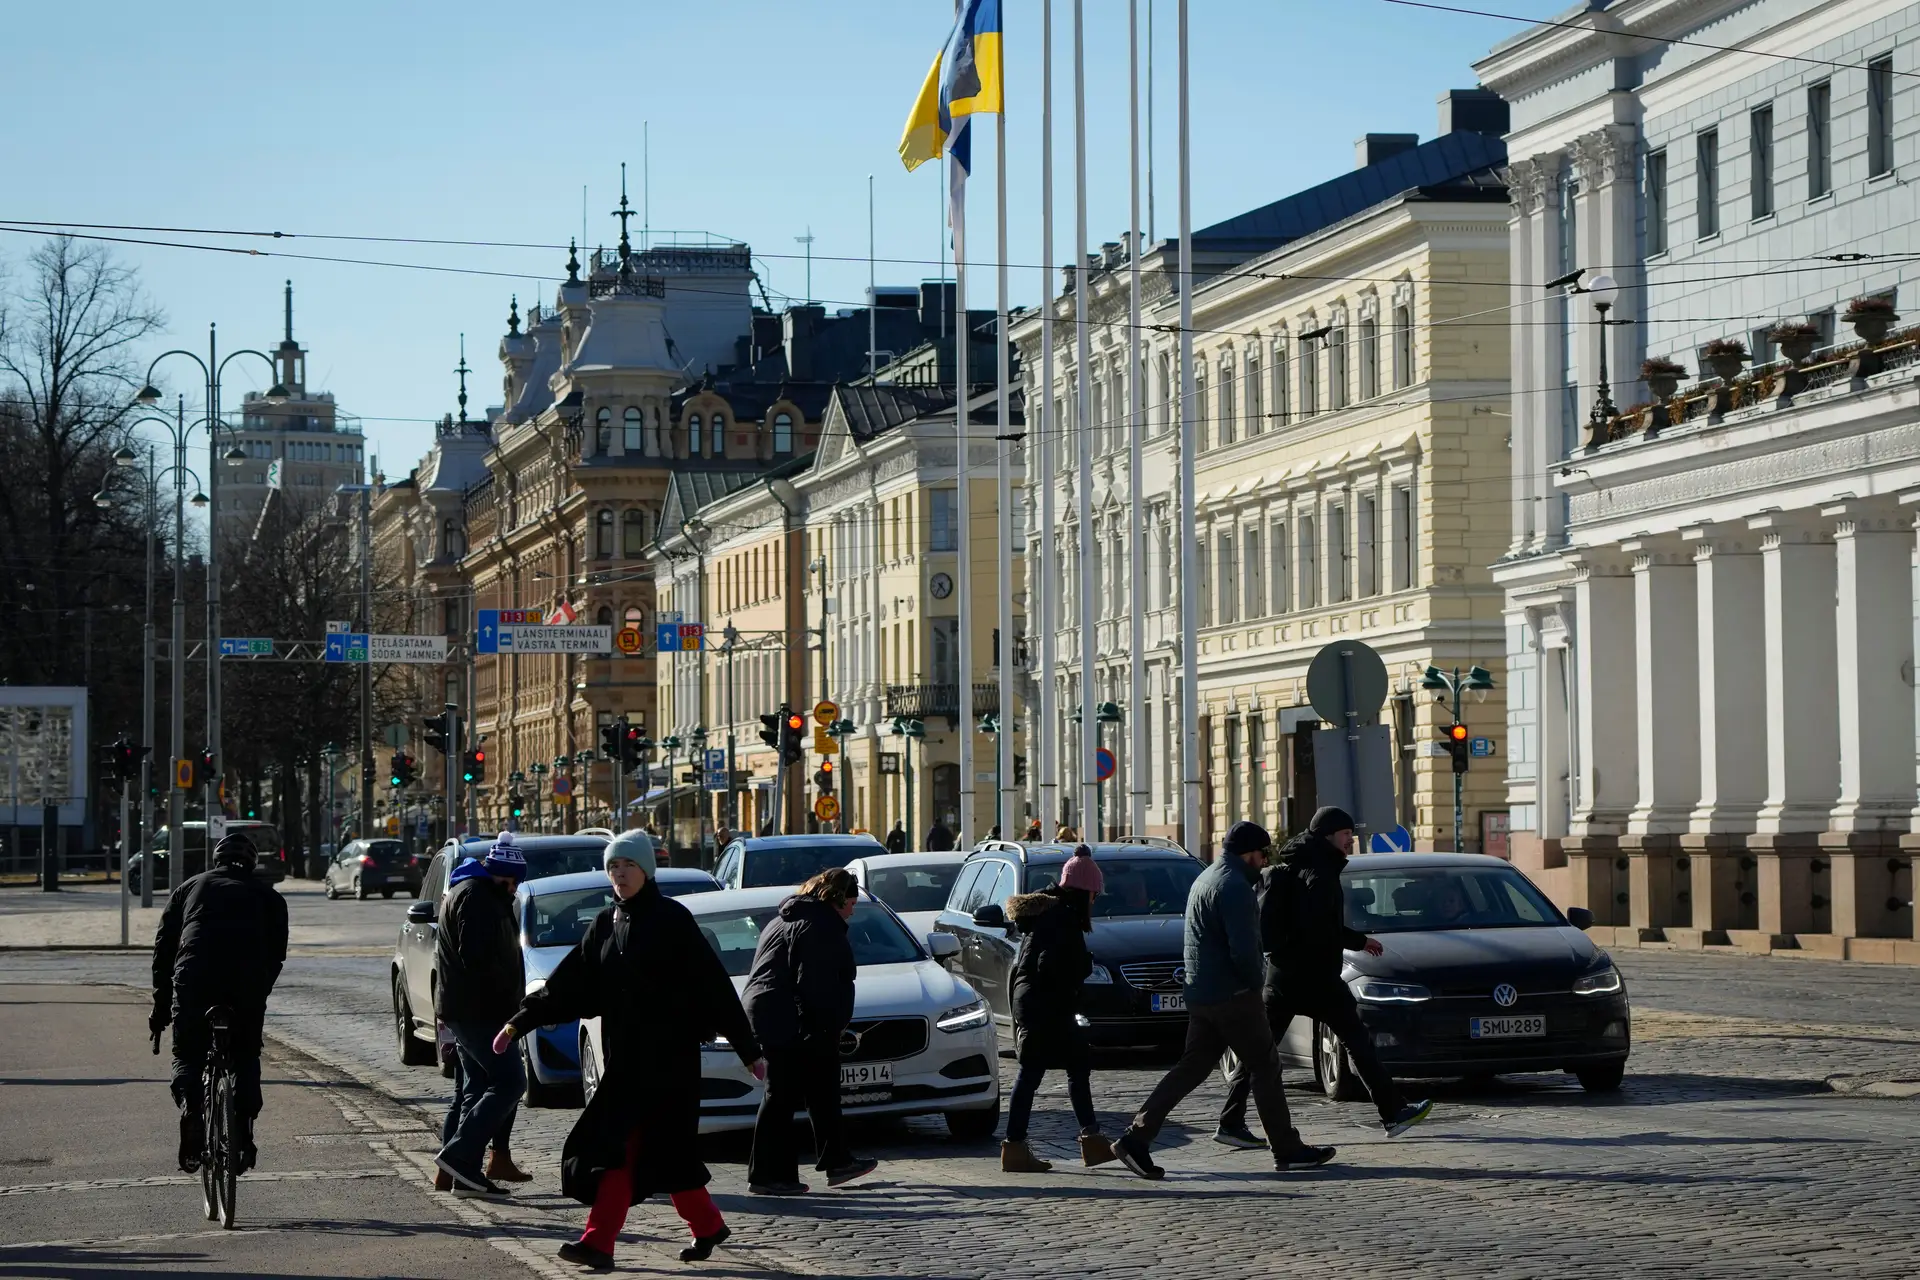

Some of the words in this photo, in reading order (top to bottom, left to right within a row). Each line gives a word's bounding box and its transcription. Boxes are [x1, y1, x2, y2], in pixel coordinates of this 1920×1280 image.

[504, 612, 508, 621] 1
[517, 612, 522, 621] 3
[529, 612, 537, 621] 51
[342, 623, 348, 631] P
[694, 627, 700, 636] 3
[516, 628, 608, 639] LÄNSITERMINAALI
[250, 642, 256, 652] E
[259, 642, 268, 651] 75
[371, 637, 433, 648] ETELÄSATAMA
[517, 639, 557, 649] VÄSTRA
[561, 640, 599, 649] TERMIN
[686, 639, 696, 649] 51
[347, 650, 353, 659] E
[355, 650, 365, 659] 75
[371, 649, 402, 659] SÖDRA
[406, 650, 444, 660] HAMNEN
[709, 751, 722, 769] P
